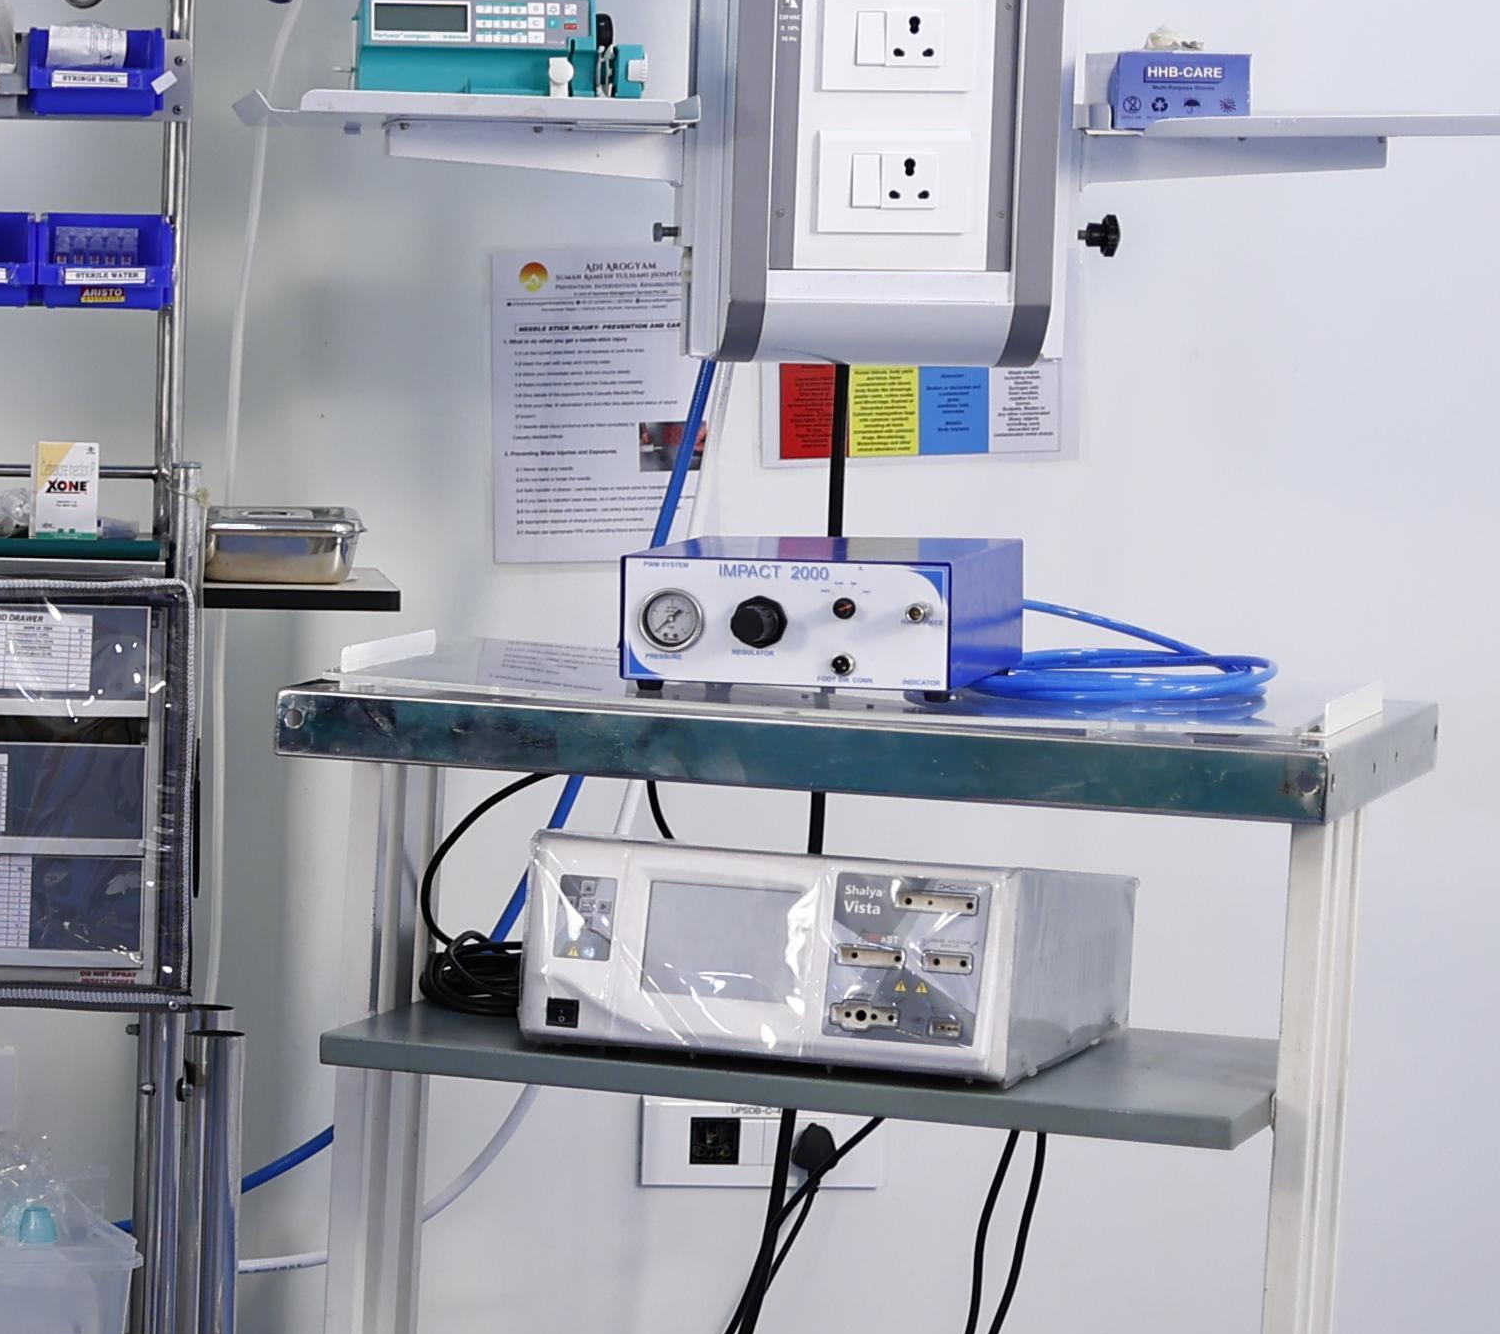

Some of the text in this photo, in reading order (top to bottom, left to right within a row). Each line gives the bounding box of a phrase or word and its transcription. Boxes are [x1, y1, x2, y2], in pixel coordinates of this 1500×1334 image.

[1147, 66, 1222, 79] HHB-CARE
[82, 288, 122, 297] ARISTO
[46, 478, 87, 494] XONE
[719, 563, 829, 581] IMPACT 2000
[9, 614, 43, 623] DRAWER
[845, 885, 883, 898] Shalya
[844, 901, 881, 915] Vista
